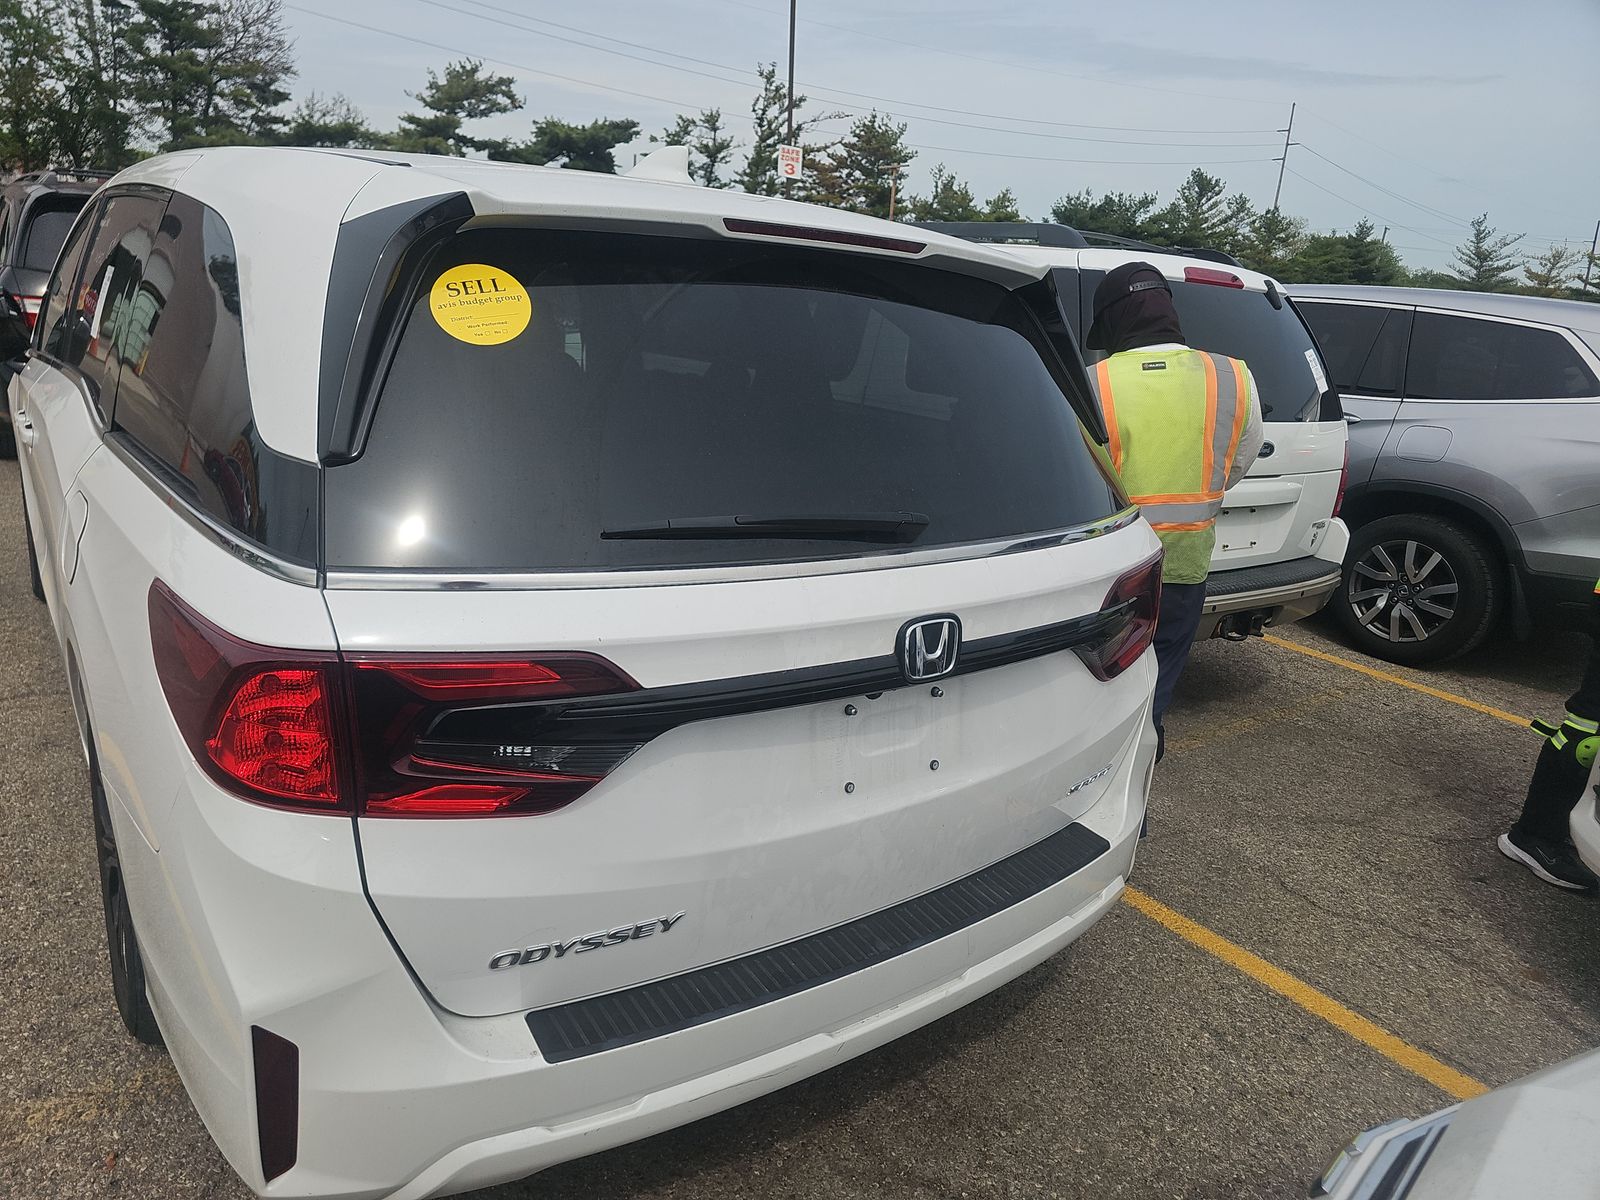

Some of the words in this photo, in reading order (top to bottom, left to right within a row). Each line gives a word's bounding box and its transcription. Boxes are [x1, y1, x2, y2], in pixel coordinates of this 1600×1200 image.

[781, 147, 800, 156] SAFE
[781, 154, 800, 162] ZONE
[784, 163, 795, 175] 3
[446, 278, 506, 297] SELL
[438, 301, 456, 309] avis
[459, 296, 493, 305] budget
[495, 294, 522, 304] group
[488, 909, 686, 969] ODYSSEY
